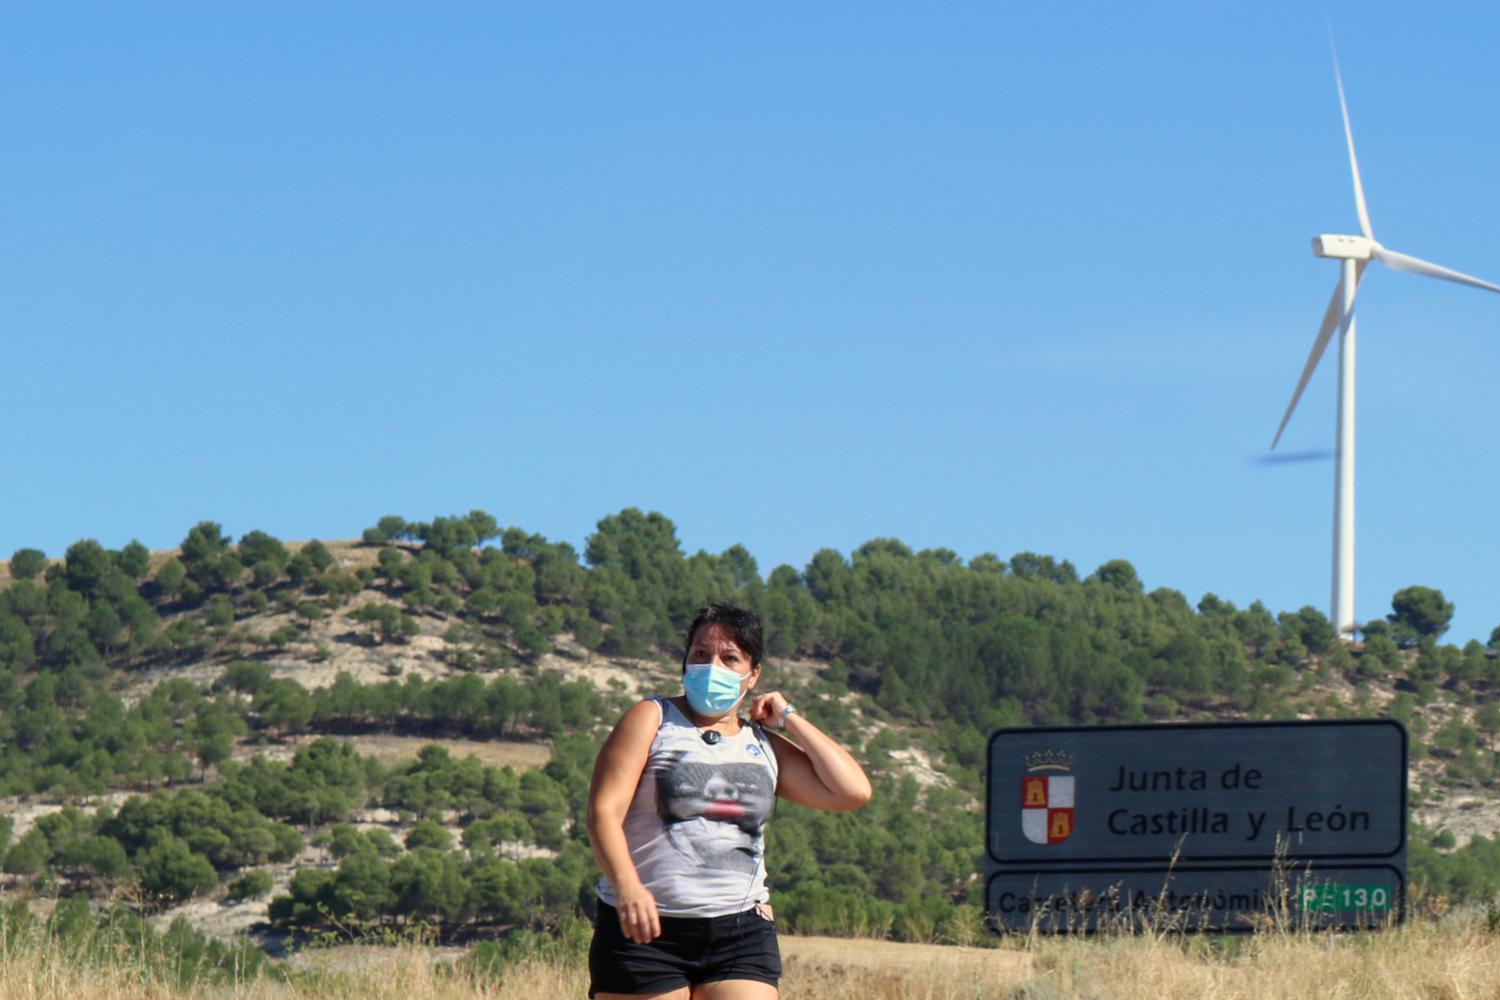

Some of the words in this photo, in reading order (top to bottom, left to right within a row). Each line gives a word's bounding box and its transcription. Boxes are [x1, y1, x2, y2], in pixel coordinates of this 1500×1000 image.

[1109, 765, 1207, 791] Junta
[1221, 762, 1263, 791] de
[1107, 806, 1228, 835] Castilla
[1246, 810, 1267, 842] y
[1285, 804, 1370, 833] León
[999, 891, 1121, 914] Caetra
[1133, 888, 1289, 912] Atonómi
